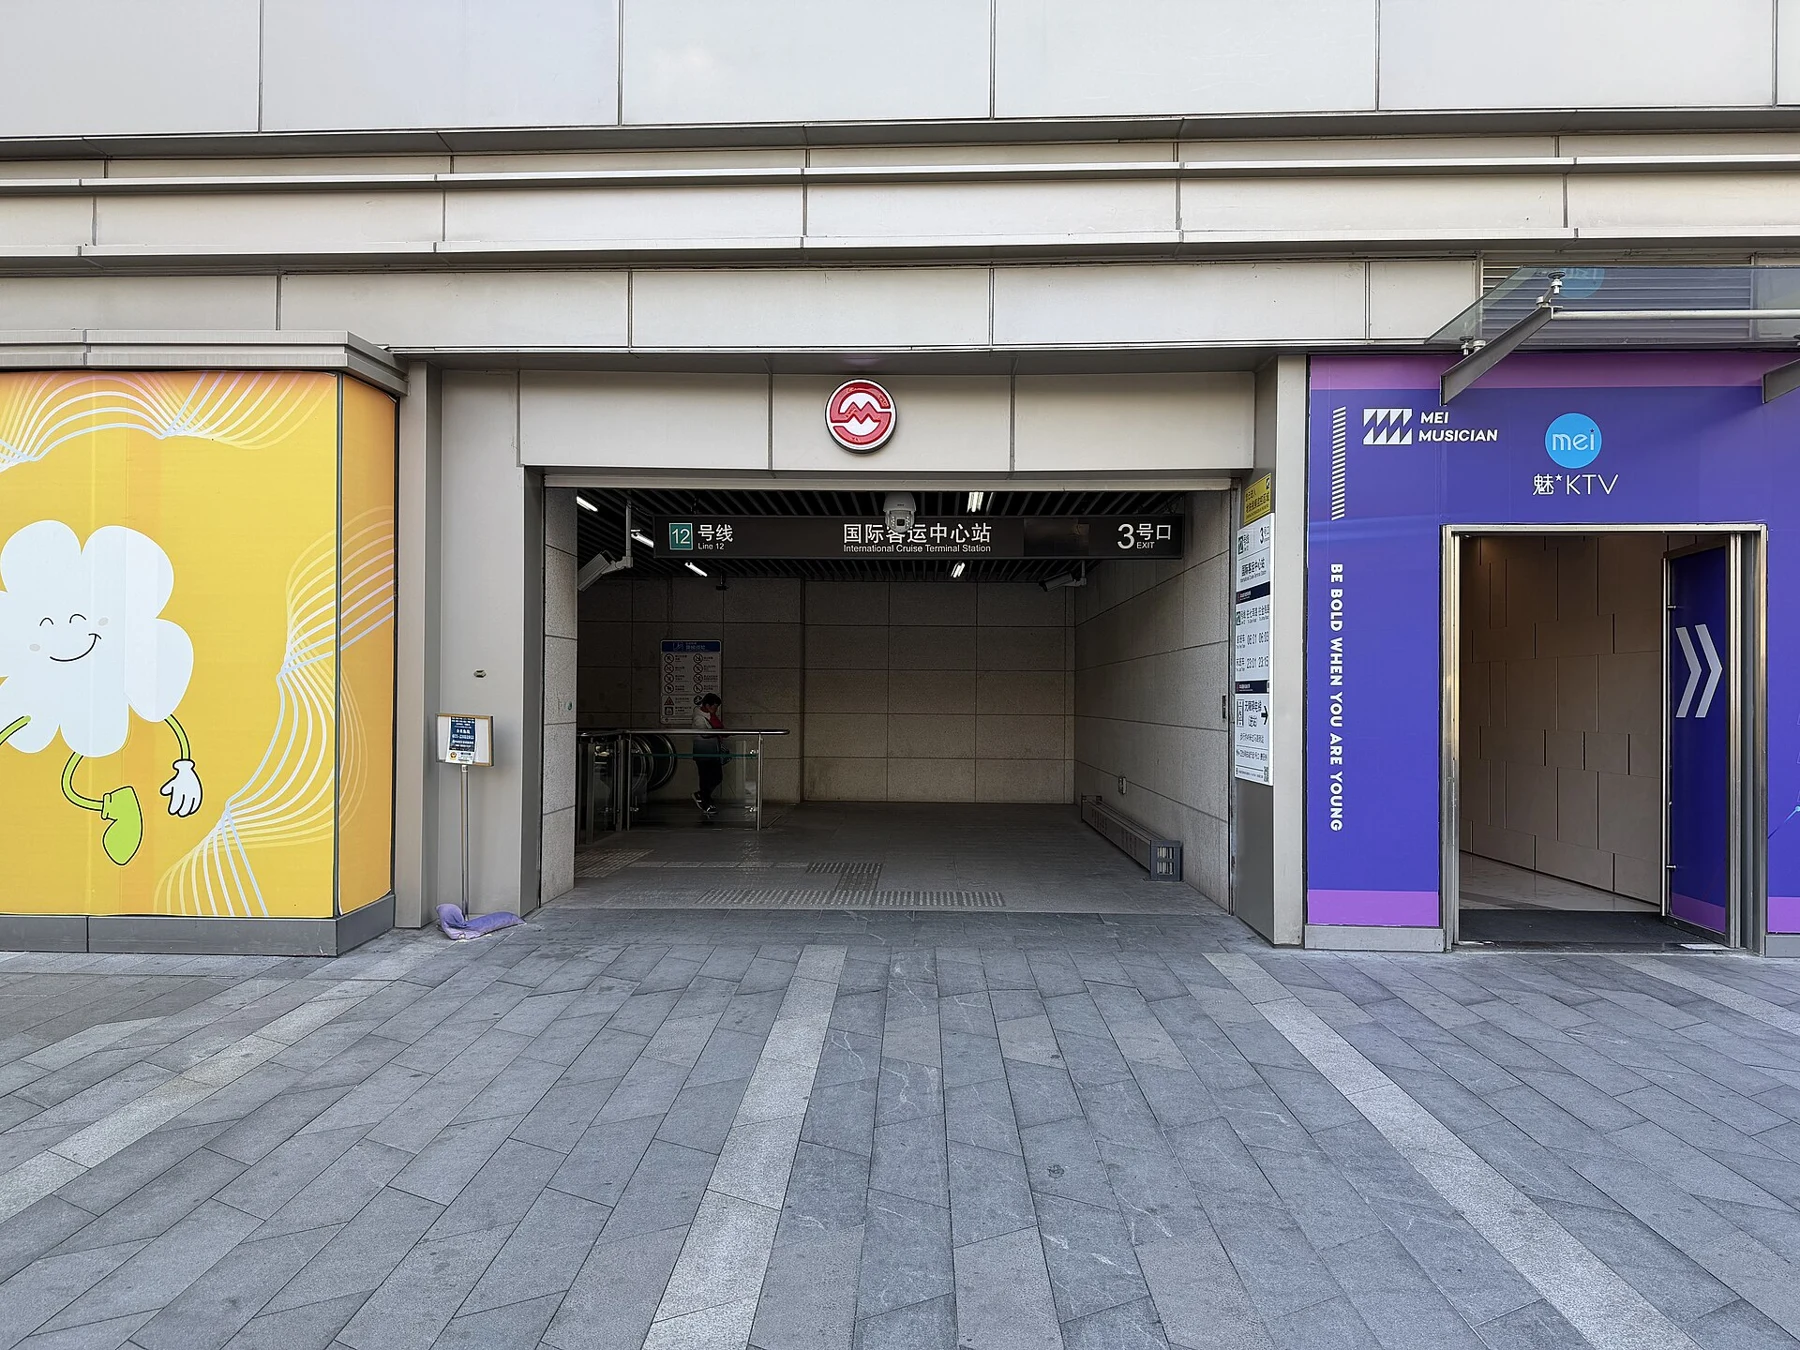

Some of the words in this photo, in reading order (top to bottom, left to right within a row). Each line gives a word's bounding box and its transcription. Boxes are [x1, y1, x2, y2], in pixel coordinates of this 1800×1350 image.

[1420, 411, 1449, 424] MEI
[1418, 429, 1498, 442] MUSICIAN
[1552, 428, 1595, 451] mei
[1532, 473, 1554, 496] 魅
[1566, 474, 1619, 495] KTV
[697, 542, 714, 550] Line
[715, 542, 725, 550] 12
[843, 544, 895, 553] International
[895, 544, 923, 553] Cruise
[925, 544, 960, 553] Terminal
[962, 544, 991, 553] Station
[1136, 541, 1155, 549] EXIT
[1330, 564, 1343, 583] BE
[1330, 589, 1343, 632] BOLD
[1330, 637, 1343, 686] WHEN
[1330, 691, 1343, 728] YOU
[1330, 733, 1343, 765] ARE
[1330, 771, 1343, 832] YOUNG
